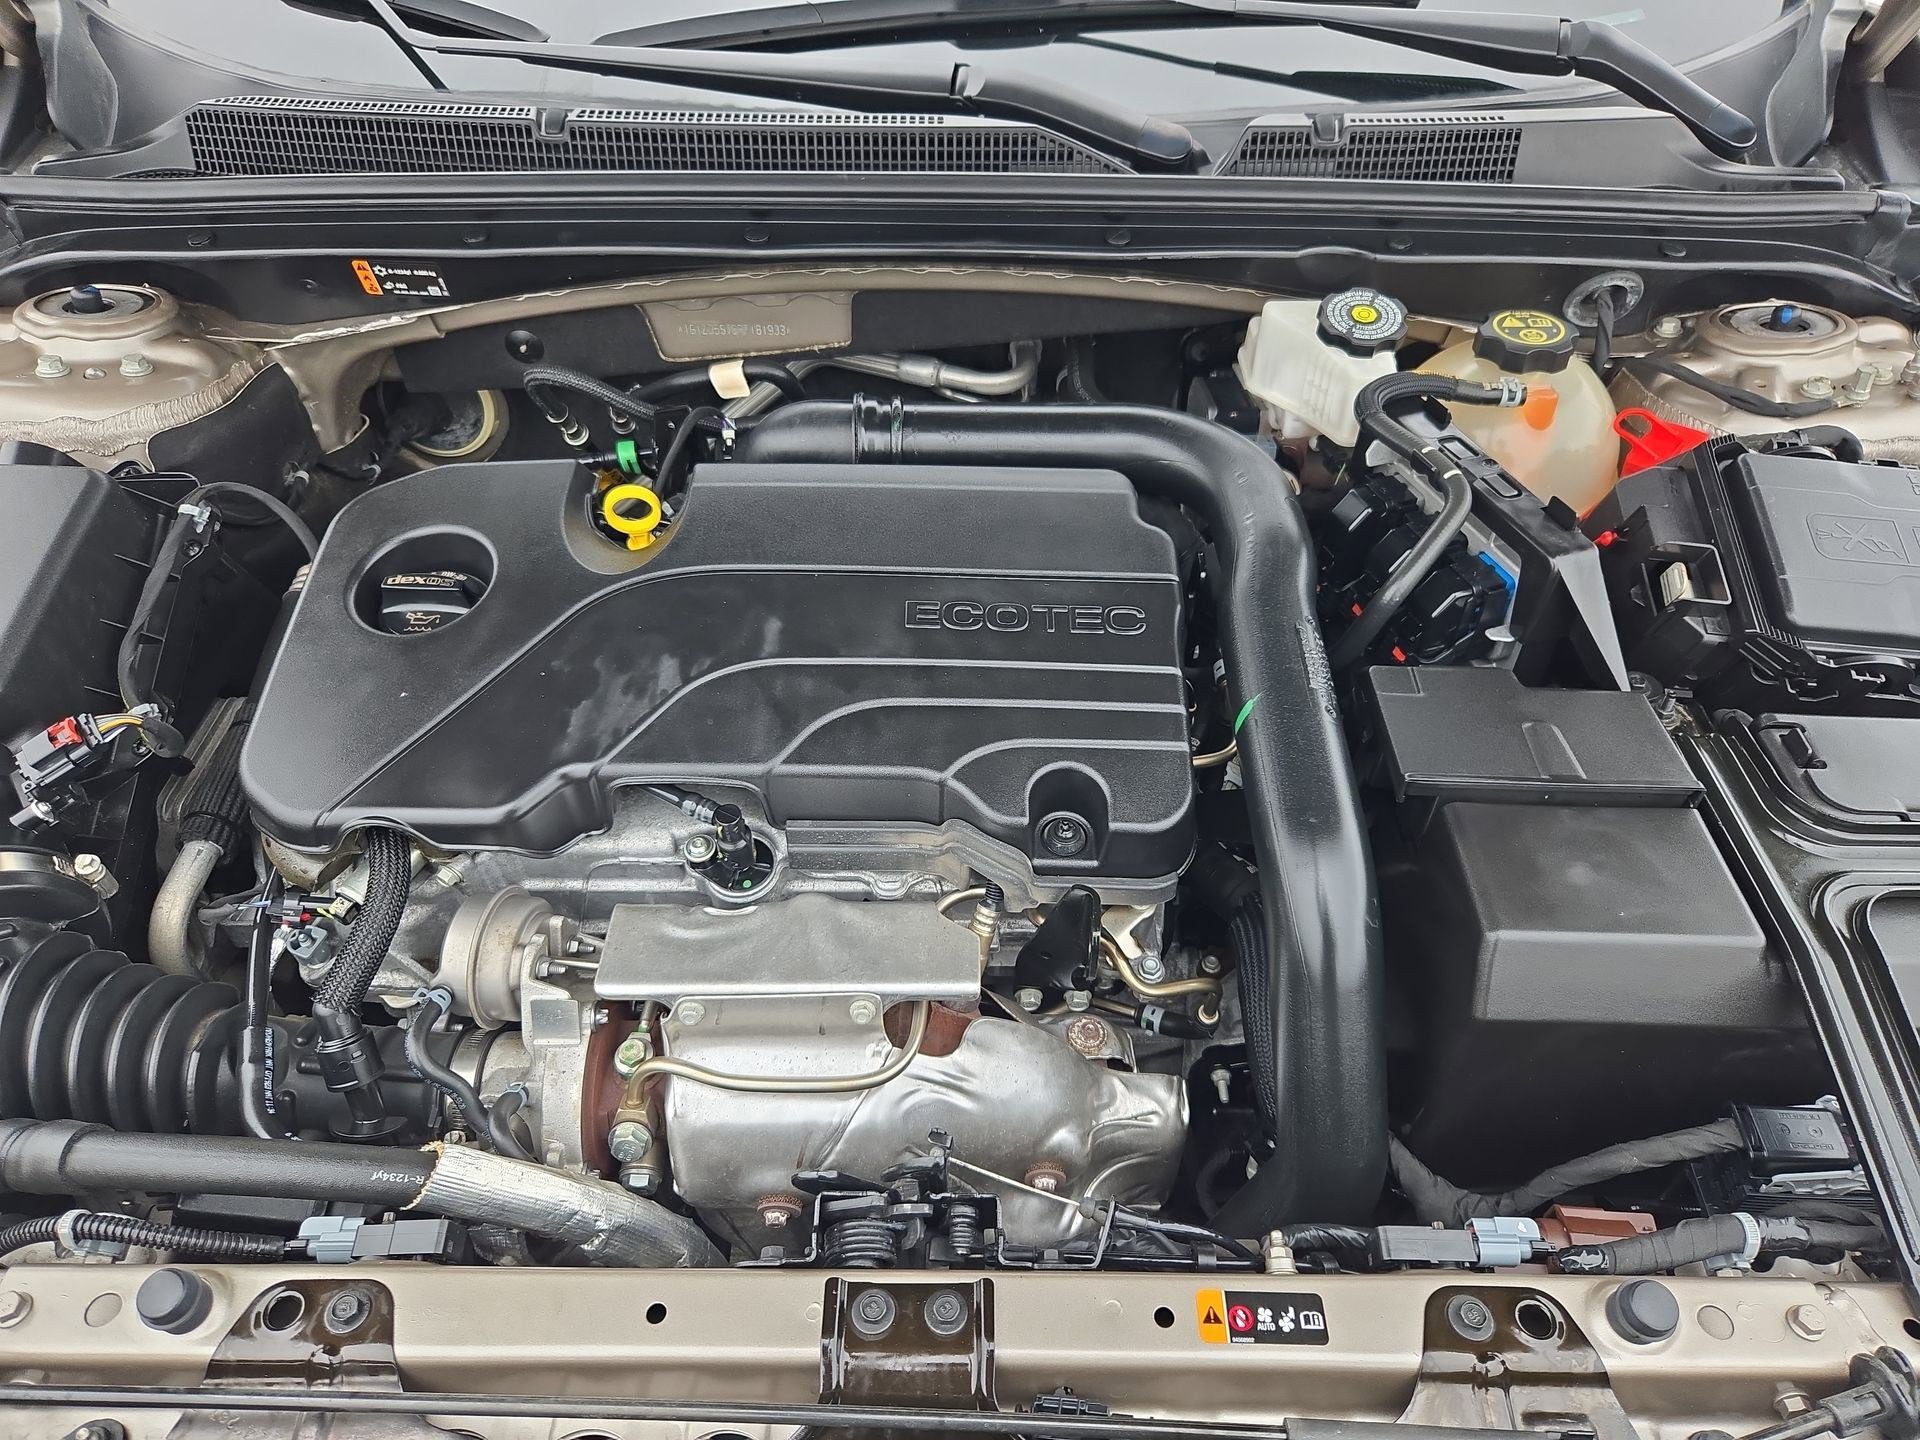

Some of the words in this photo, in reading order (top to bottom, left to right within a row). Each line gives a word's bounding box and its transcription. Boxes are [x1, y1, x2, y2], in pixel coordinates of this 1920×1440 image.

[904, 600, 1147, 636] ECOTEC
[370, 1170, 425, 1185] R-1234yf
[1257, 1322, 1276, 1331] AUTO
